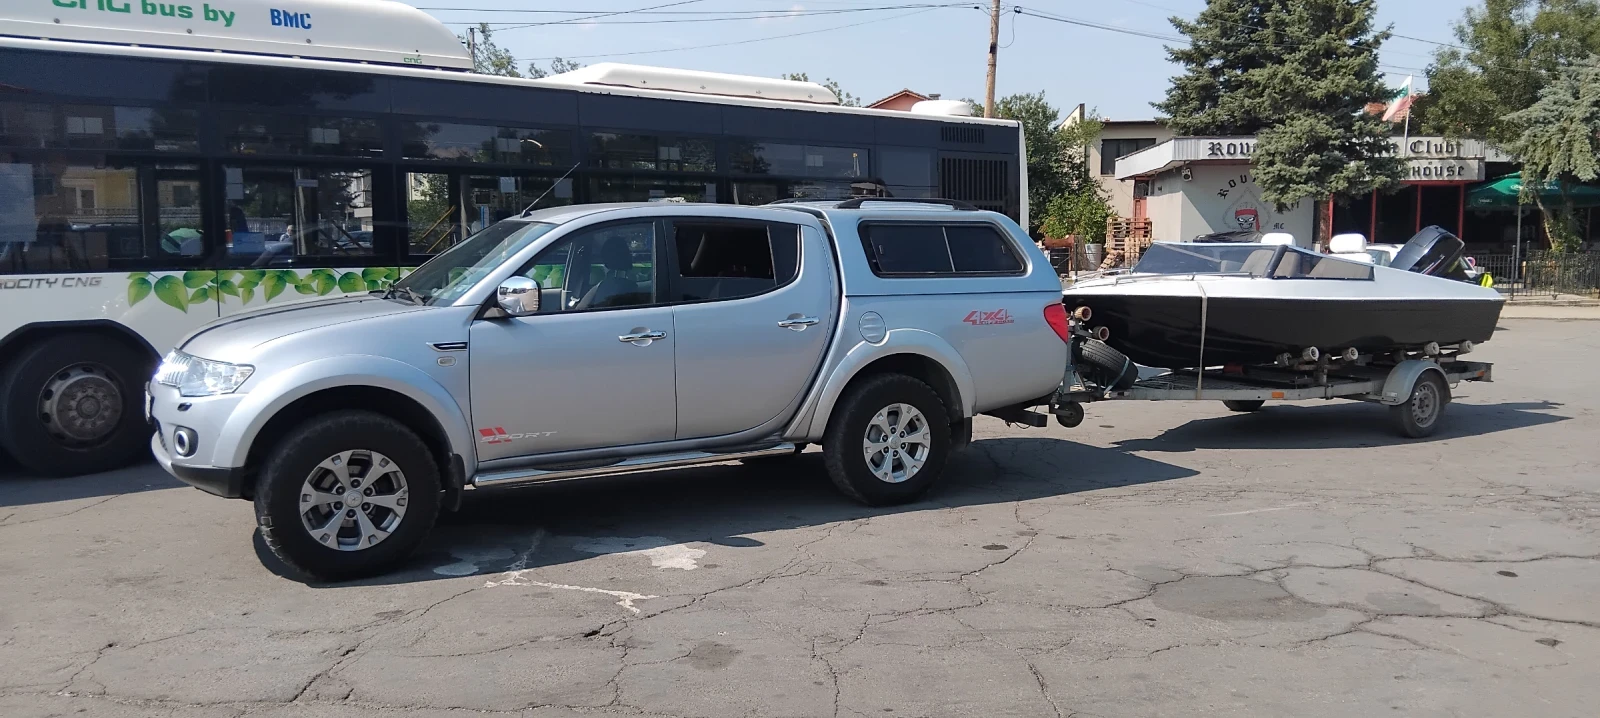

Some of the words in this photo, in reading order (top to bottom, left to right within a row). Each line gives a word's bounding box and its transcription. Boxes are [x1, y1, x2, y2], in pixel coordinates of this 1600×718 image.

[141, 0, 193, 18] bus
[203, 3, 235, 27] by
[270, 8, 312, 29] BMC
[1409, 139, 1454, 154] Club
[61, 276, 103, 288] CNG
[480, 431, 557, 442] SPORT
